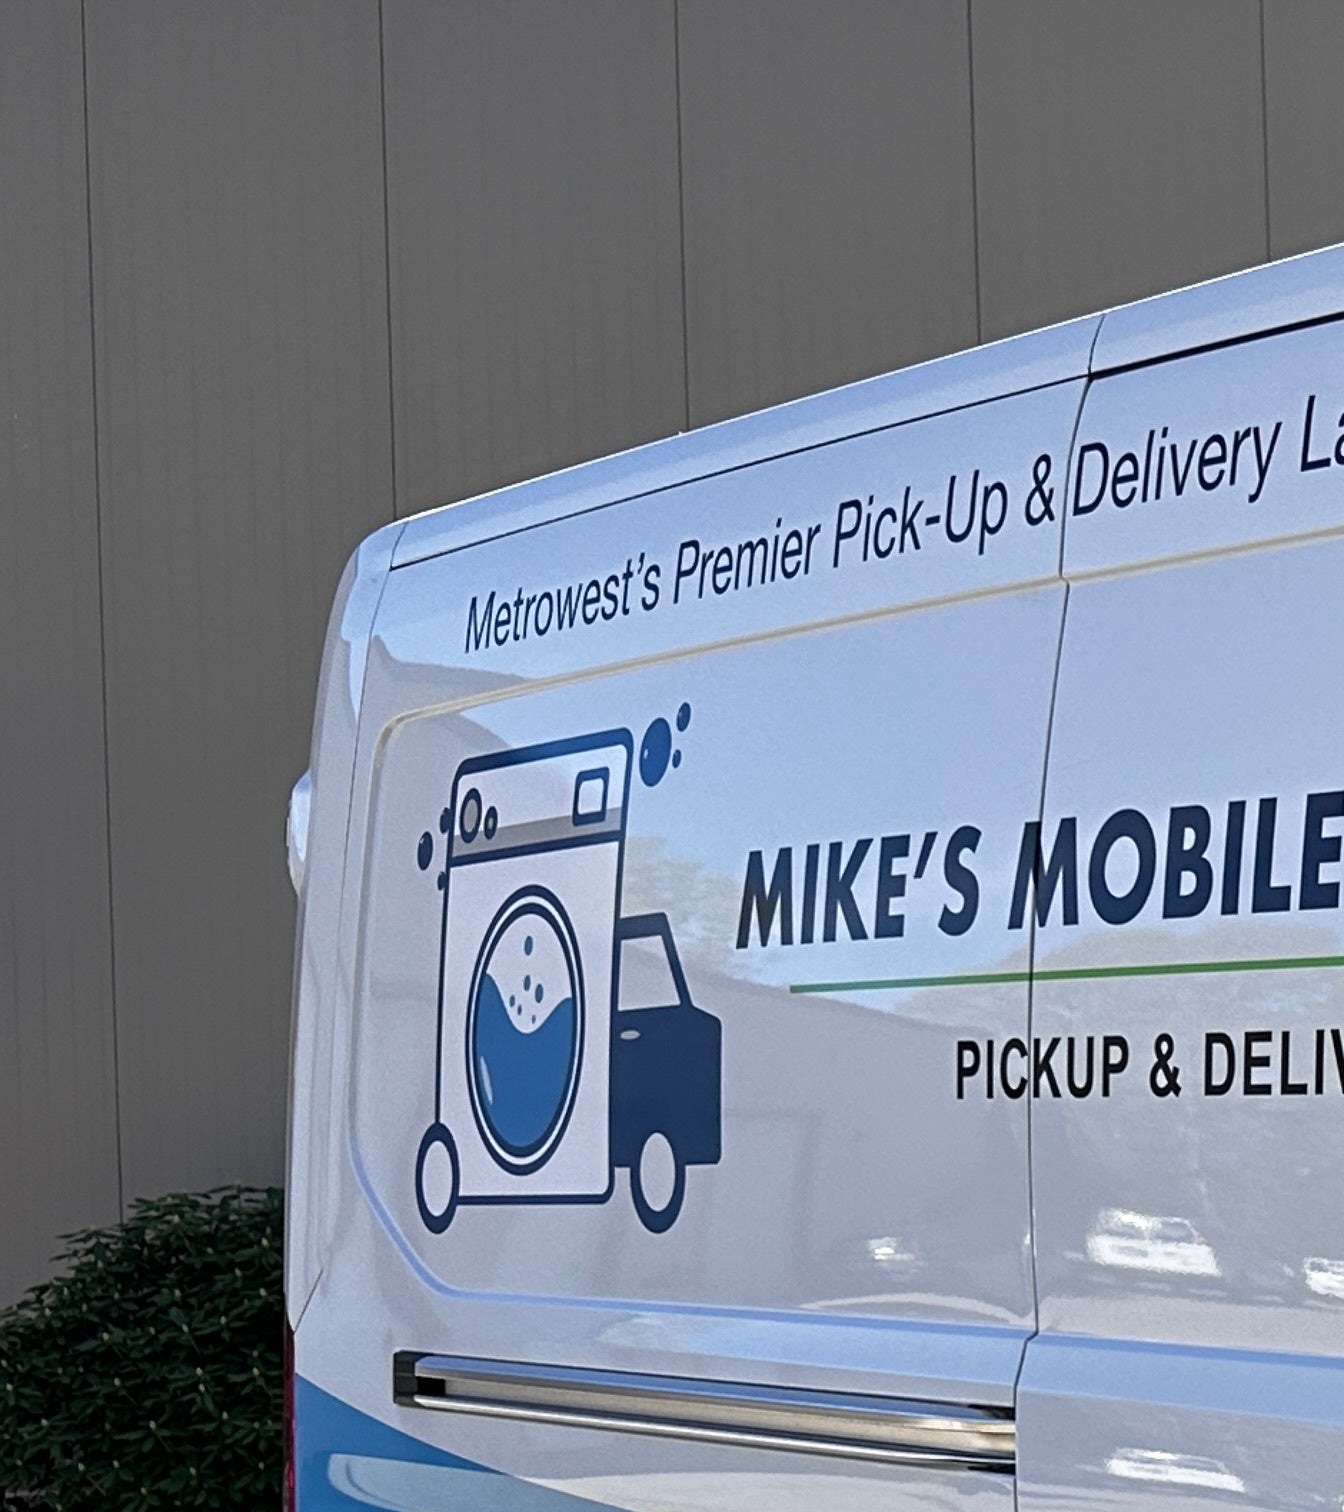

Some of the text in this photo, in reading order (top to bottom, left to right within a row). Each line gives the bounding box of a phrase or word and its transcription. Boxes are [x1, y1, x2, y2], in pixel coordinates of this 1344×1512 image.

[465, 552, 660, 653] Metrowest's
[673, 517, 821, 605] Premier
[832, 469, 1008, 568] Pick-Up
[1024, 453, 1056, 526] &
[1072, 417, 1283, 517] Delivery
[735, 824, 983, 950] MIKE'S
[956, 1035, 1130, 1099] PICKUP
[1149, 1031, 1182, 1098] &
